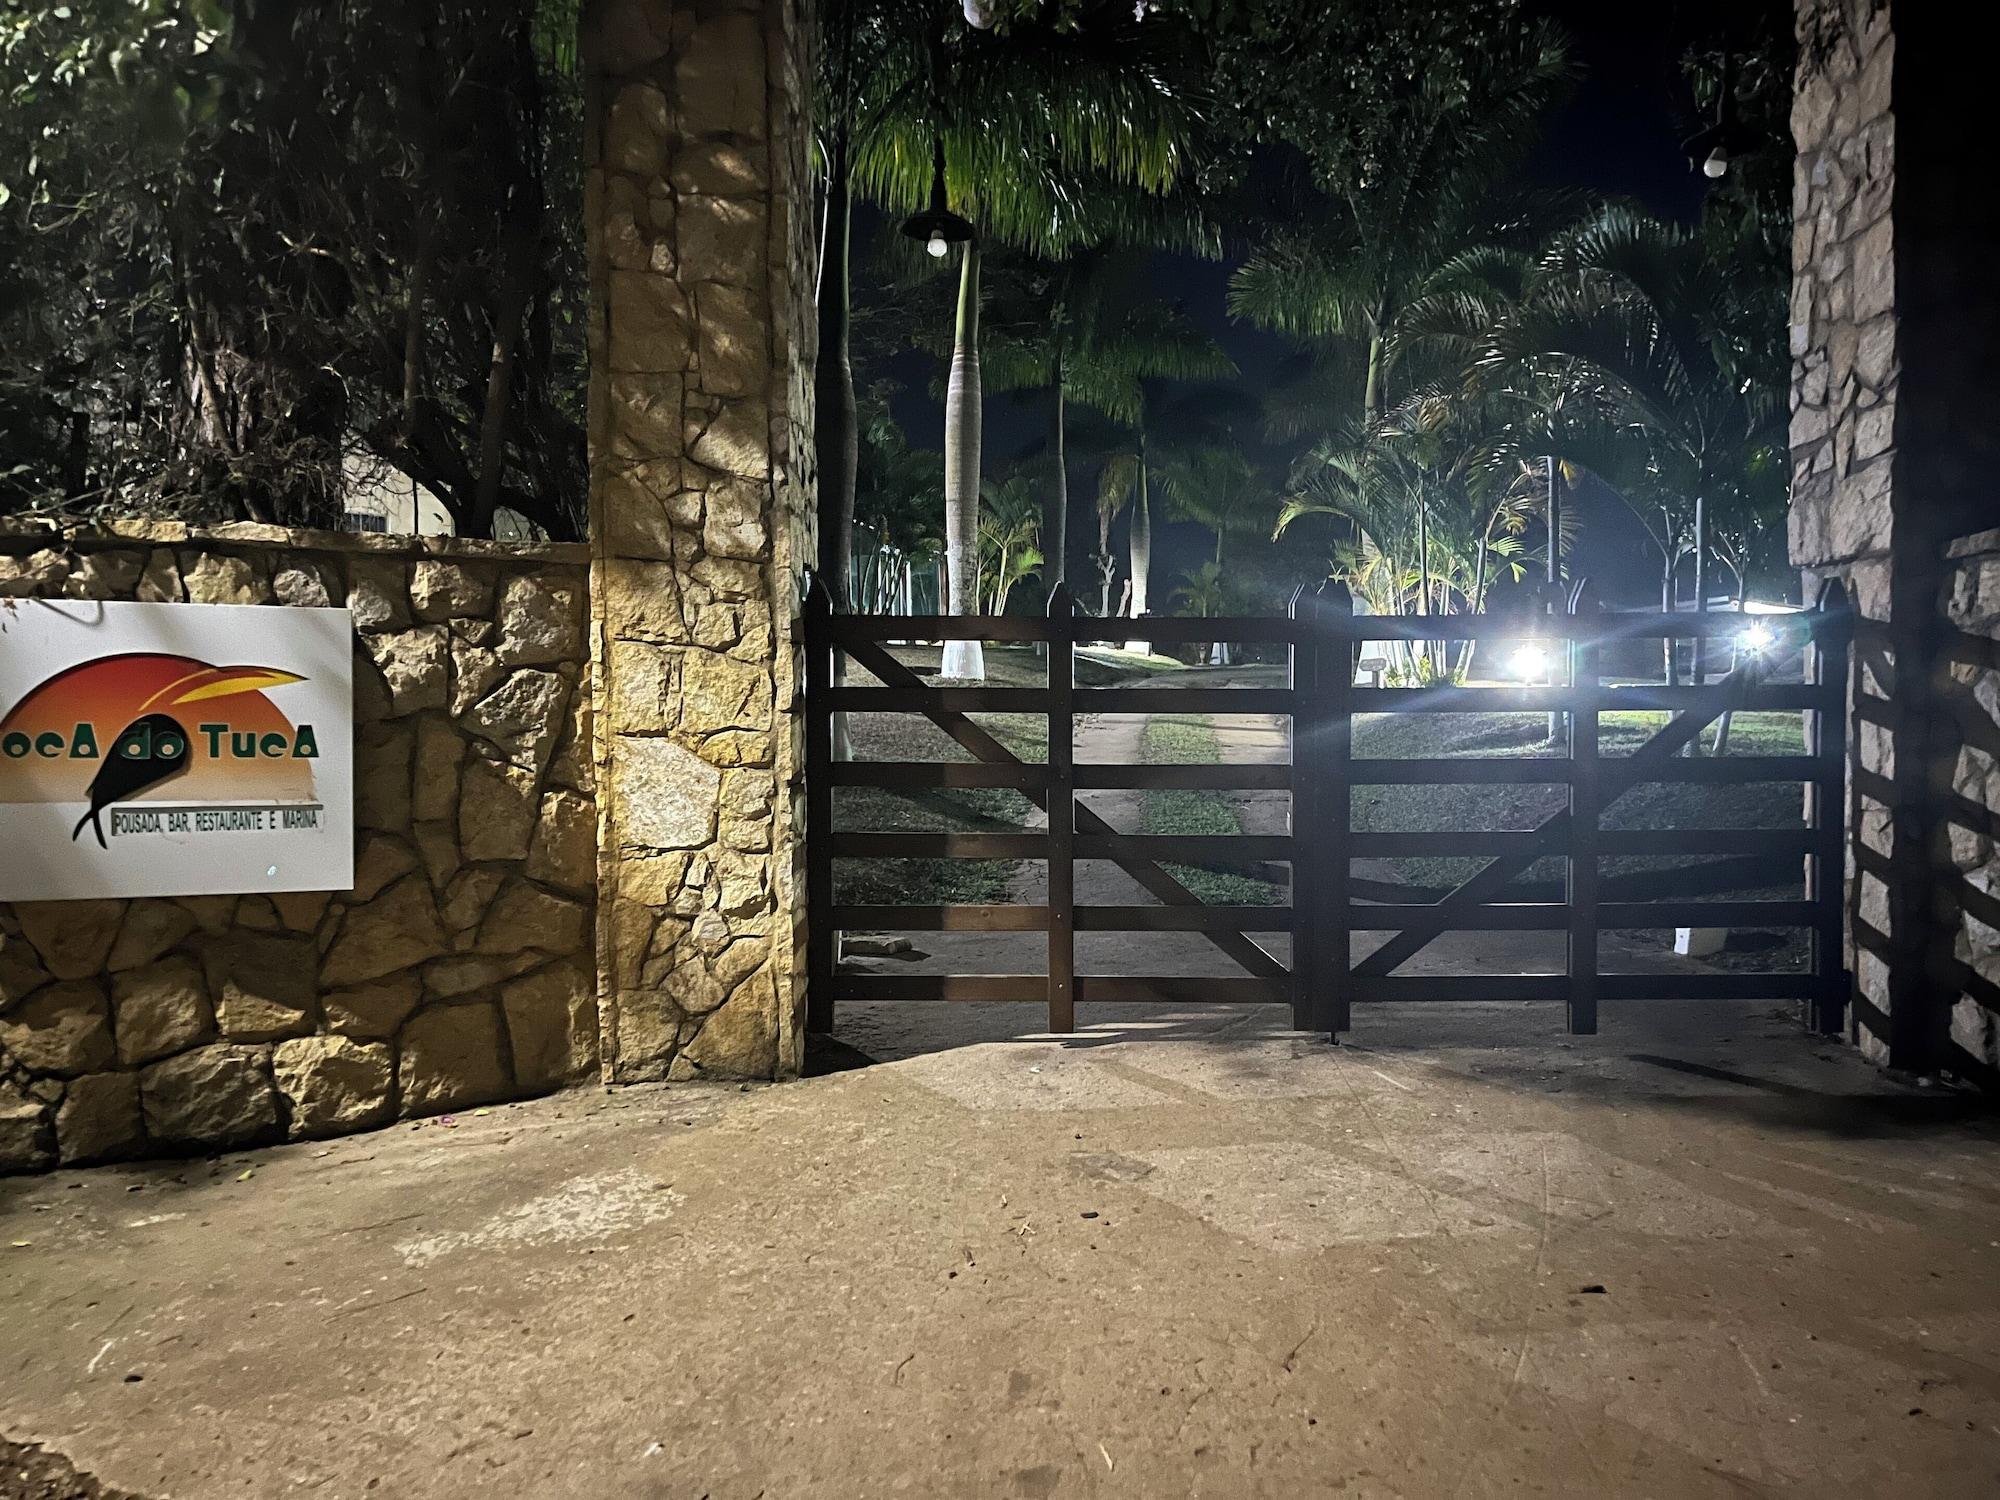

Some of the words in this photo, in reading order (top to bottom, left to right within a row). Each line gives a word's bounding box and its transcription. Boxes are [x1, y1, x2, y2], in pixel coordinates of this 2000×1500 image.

[119, 723, 185, 760] do
[196, 811, 262, 831] RESTAURANTE
[270, 810, 276, 830] E
[283, 808, 318, 829] MARINA
